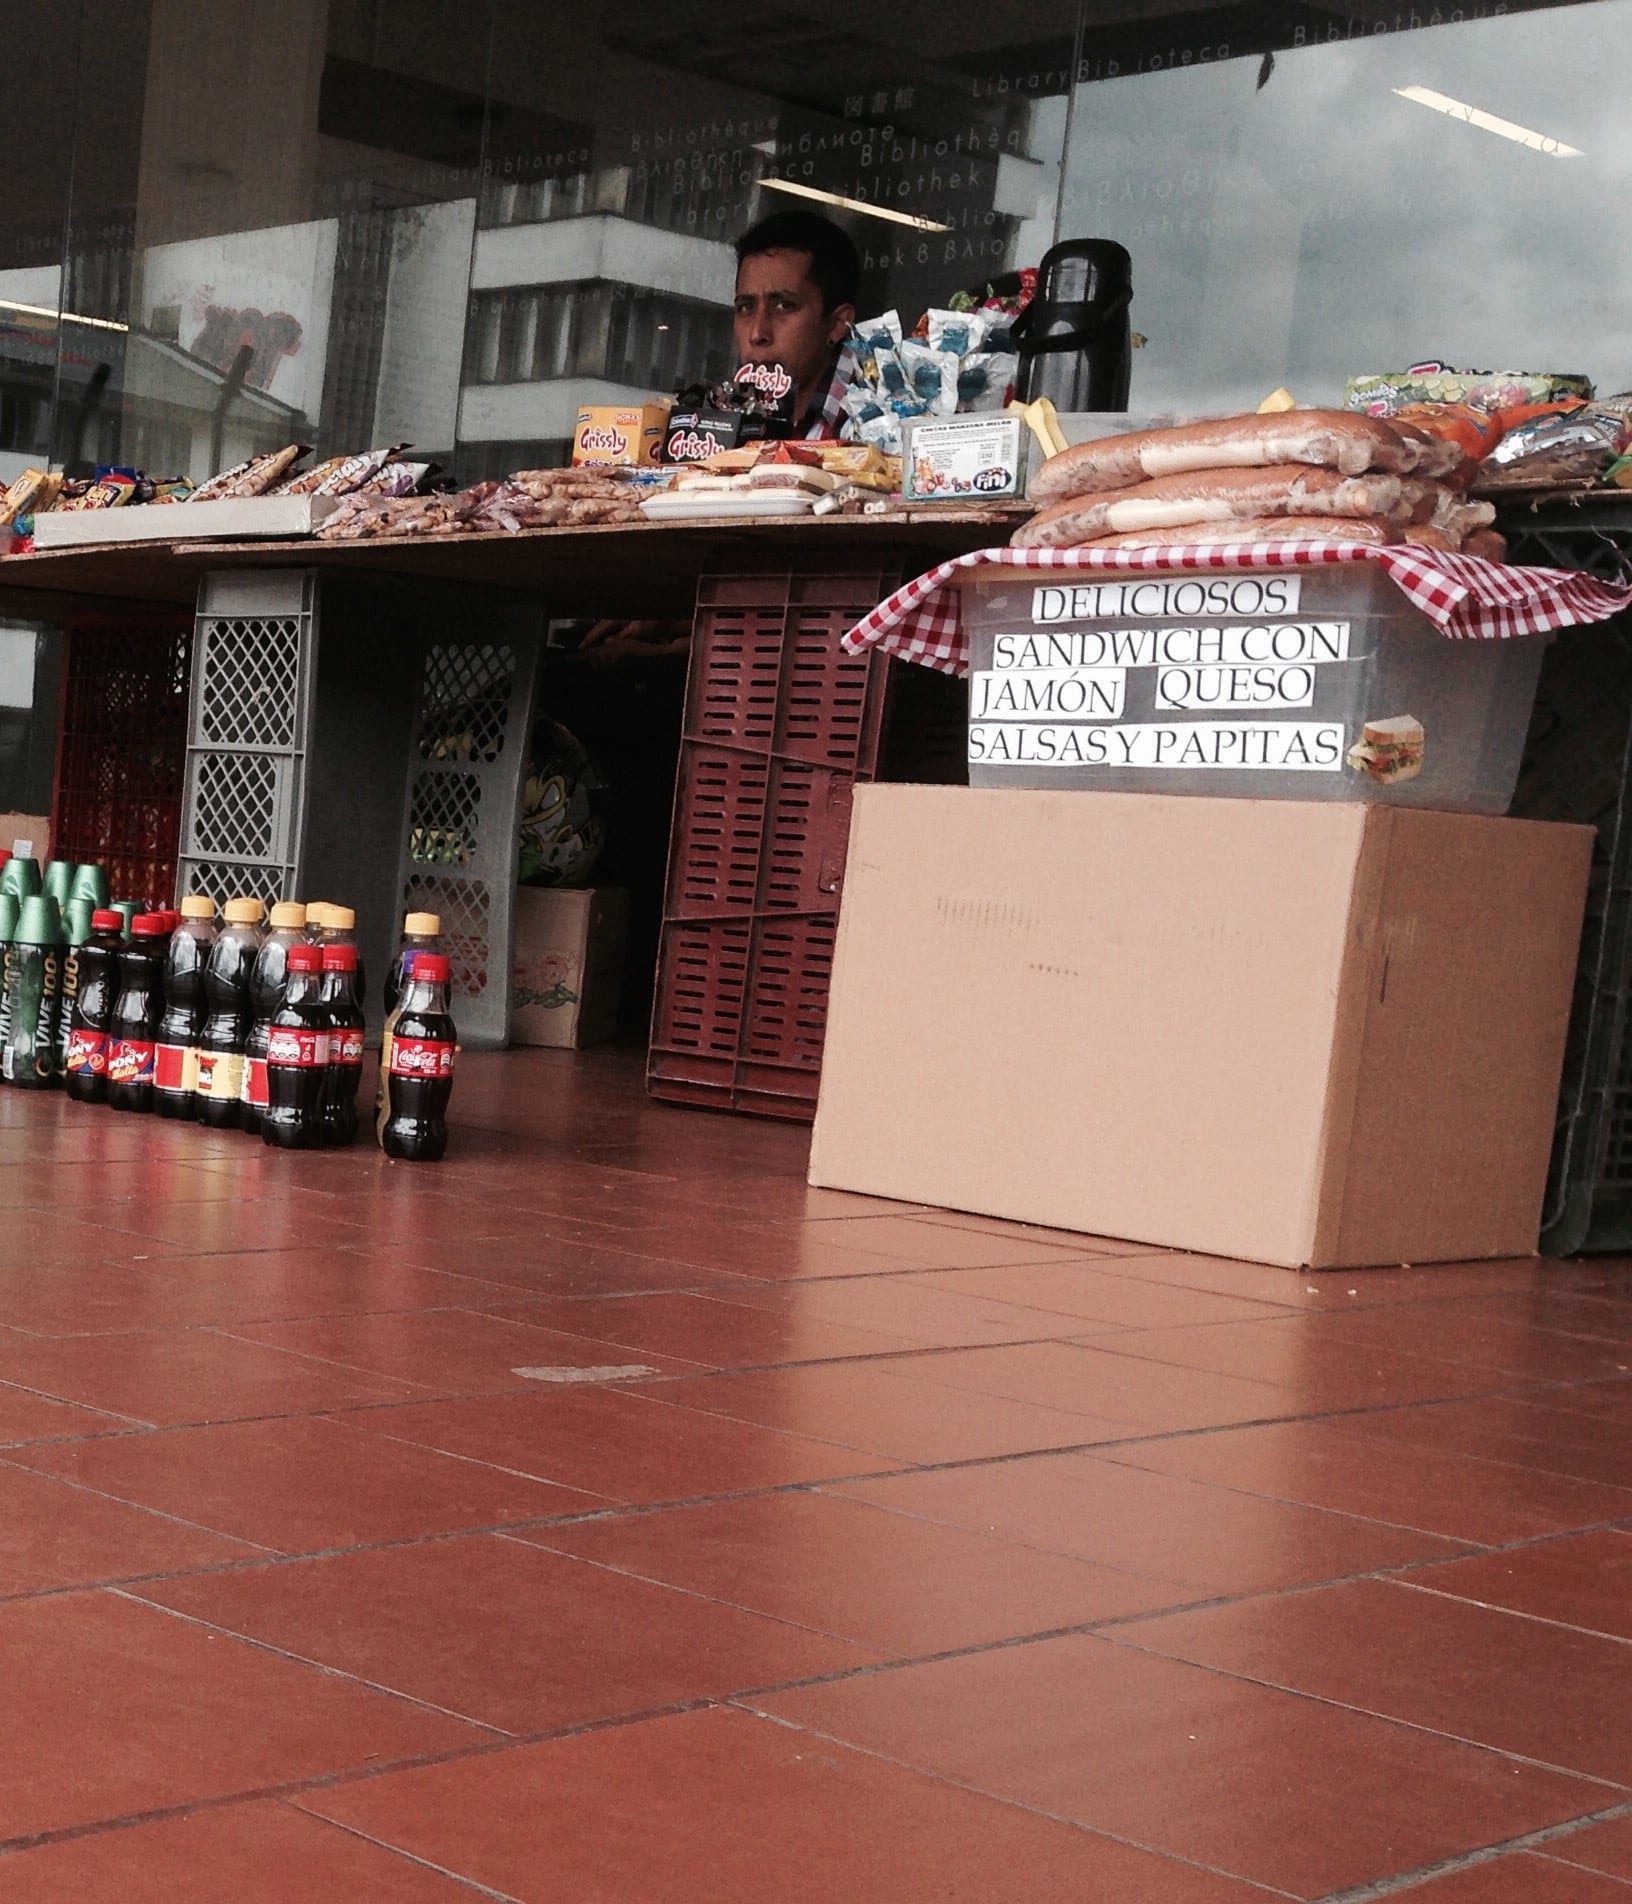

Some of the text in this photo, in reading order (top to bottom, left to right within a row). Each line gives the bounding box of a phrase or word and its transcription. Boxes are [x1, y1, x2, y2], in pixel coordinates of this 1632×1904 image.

[971, 70, 1069, 98] Library
[580, 426, 628, 456] Grissly
[976, 467, 1007, 490] Fini
[1038, 577, 1289, 622] DELICIOSOS
[994, 623, 1346, 670] SANDWICH CON
[978, 666, 1313, 717] JAMÓN QUESO
[968, 726, 1341, 765] SALSAS Y PAPITAS
[109, 1052, 148, 1072] PONY
